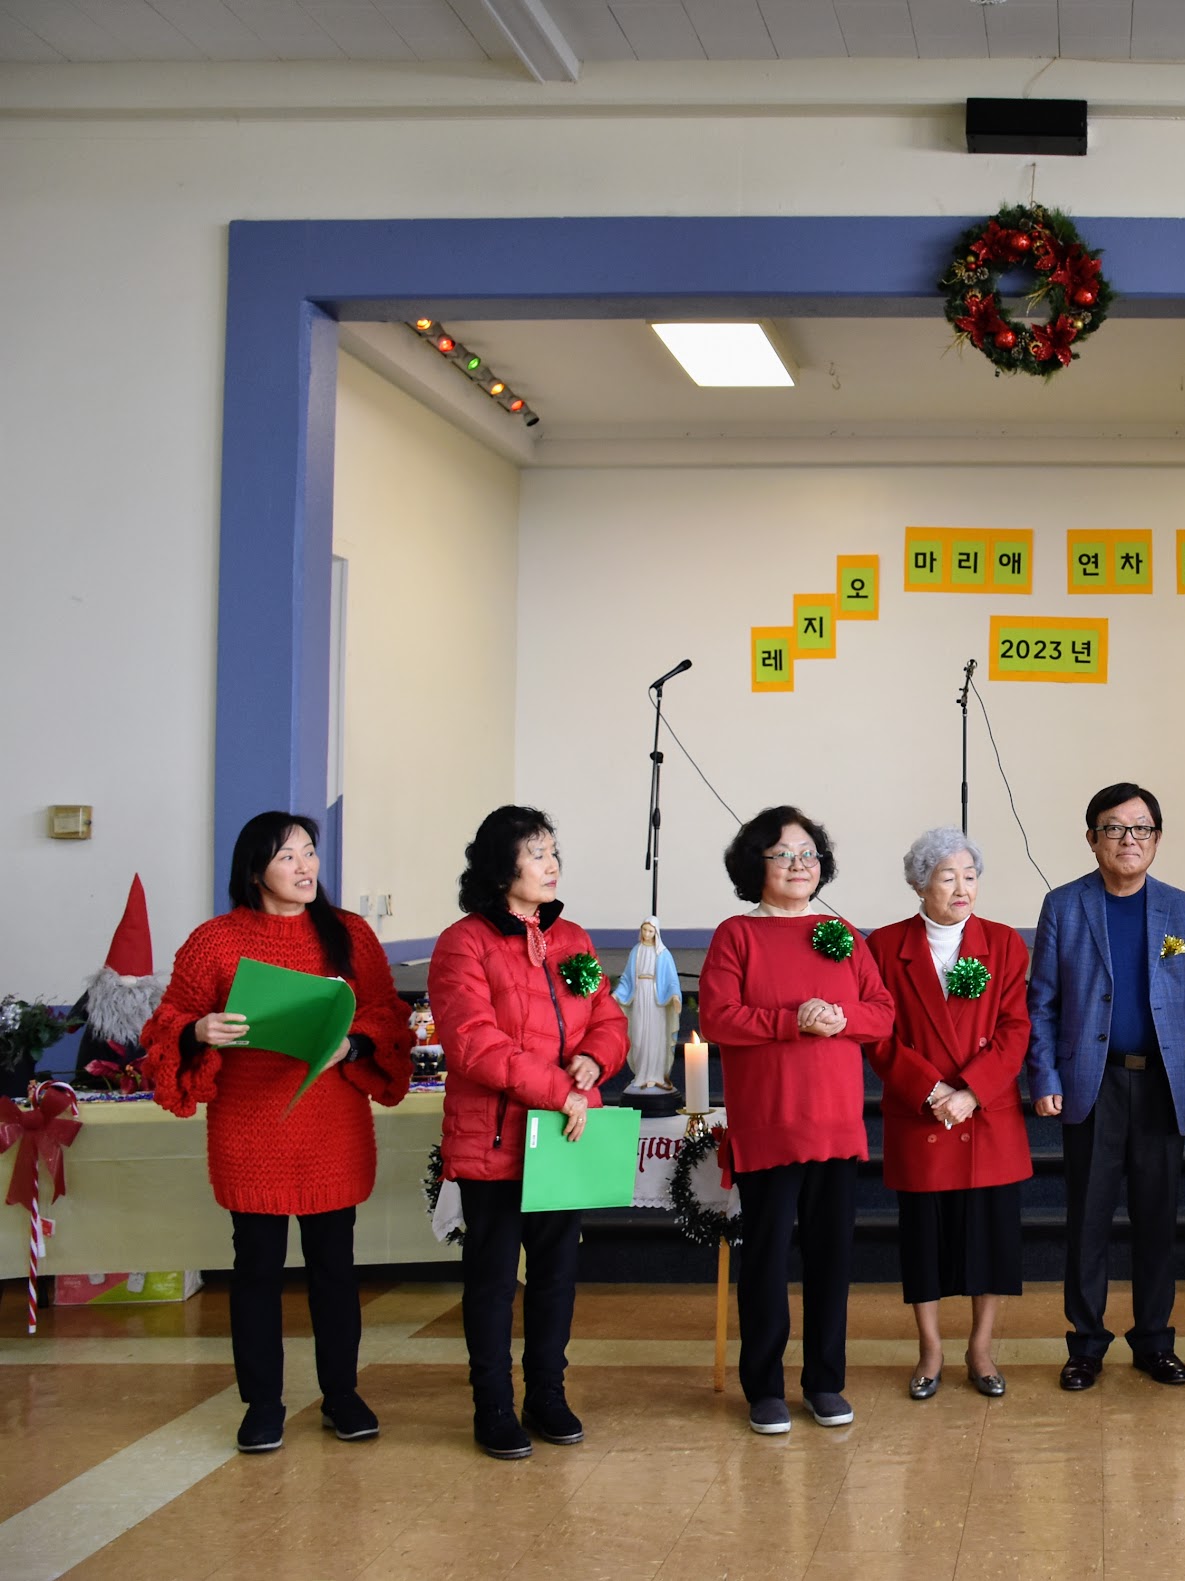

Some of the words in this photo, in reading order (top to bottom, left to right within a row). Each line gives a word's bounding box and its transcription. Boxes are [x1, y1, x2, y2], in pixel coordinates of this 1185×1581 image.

[914, 551, 1022, 575] 마리애
[1078, 552, 1143, 577] 연차
[1000, 639, 1062, 660] 2023
[1071, 640, 1091, 664] 년
